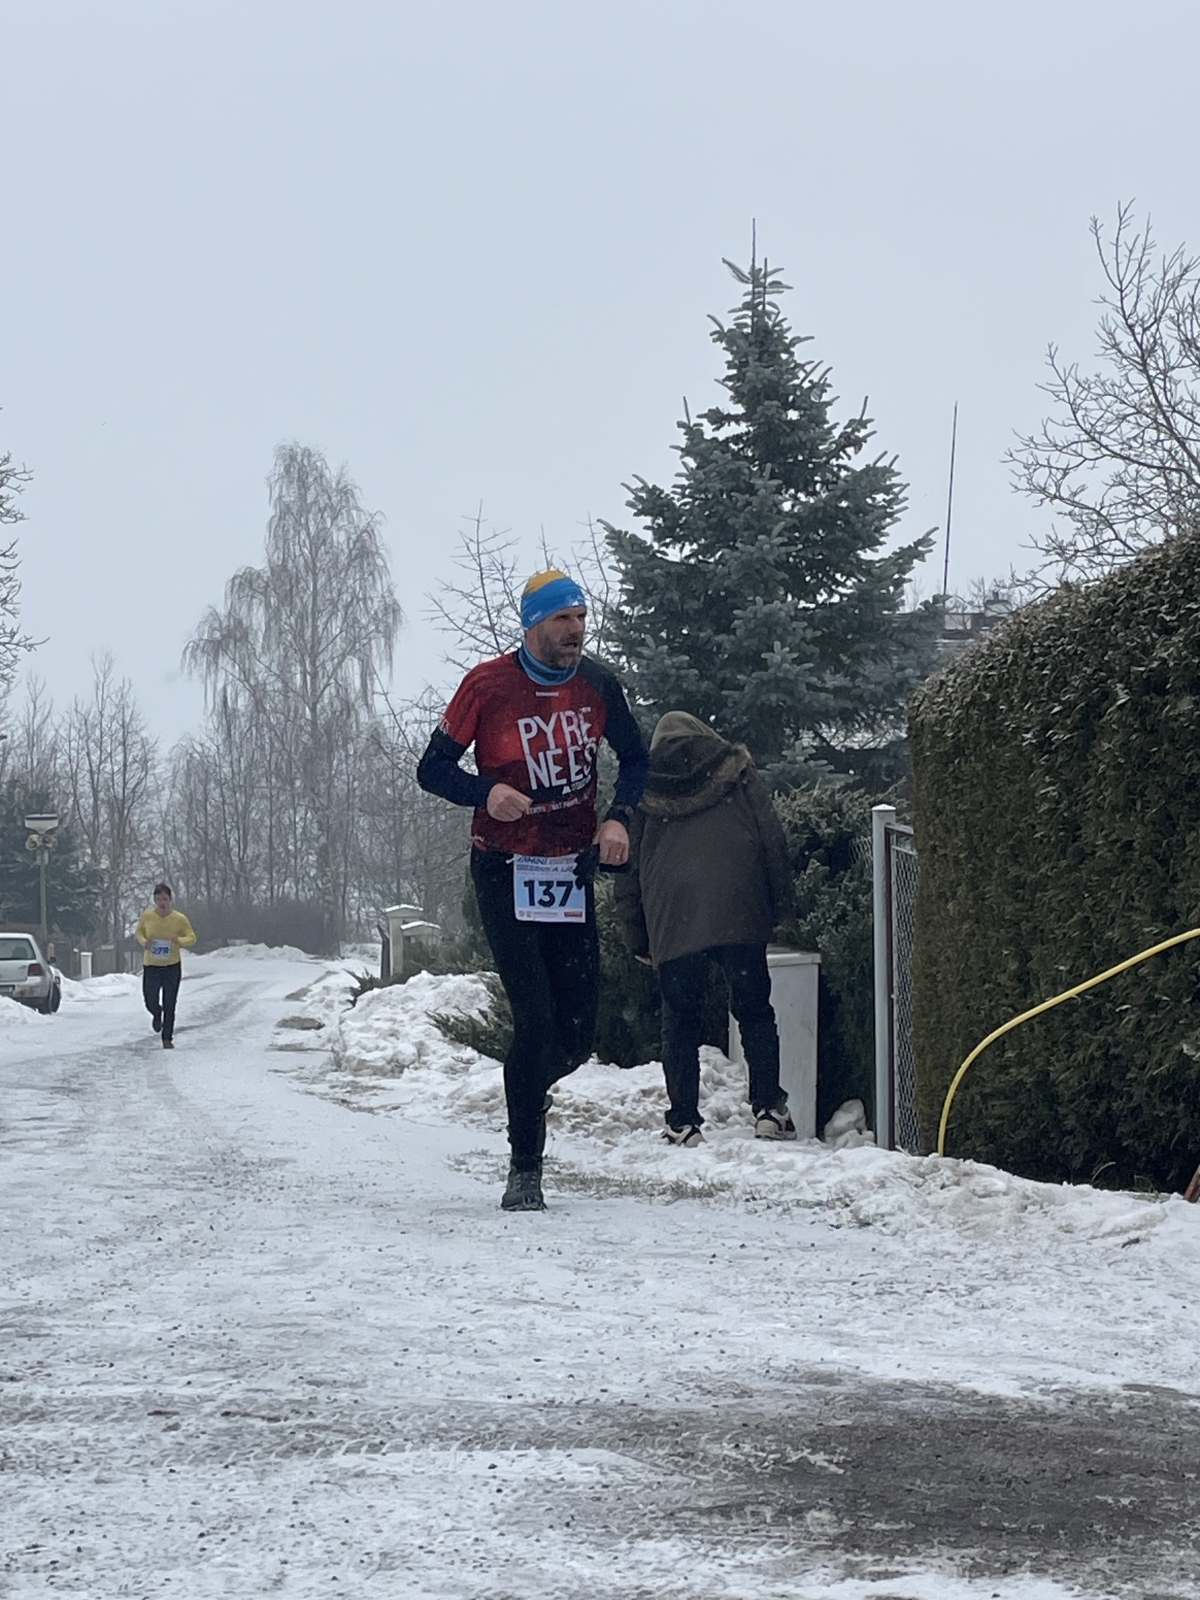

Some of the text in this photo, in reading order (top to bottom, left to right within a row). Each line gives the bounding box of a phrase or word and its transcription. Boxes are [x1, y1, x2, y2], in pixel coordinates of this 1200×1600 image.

[517, 707, 596, 755] PYRE
[525, 742, 597, 790] NEES
[523, 880, 574, 908] 137
